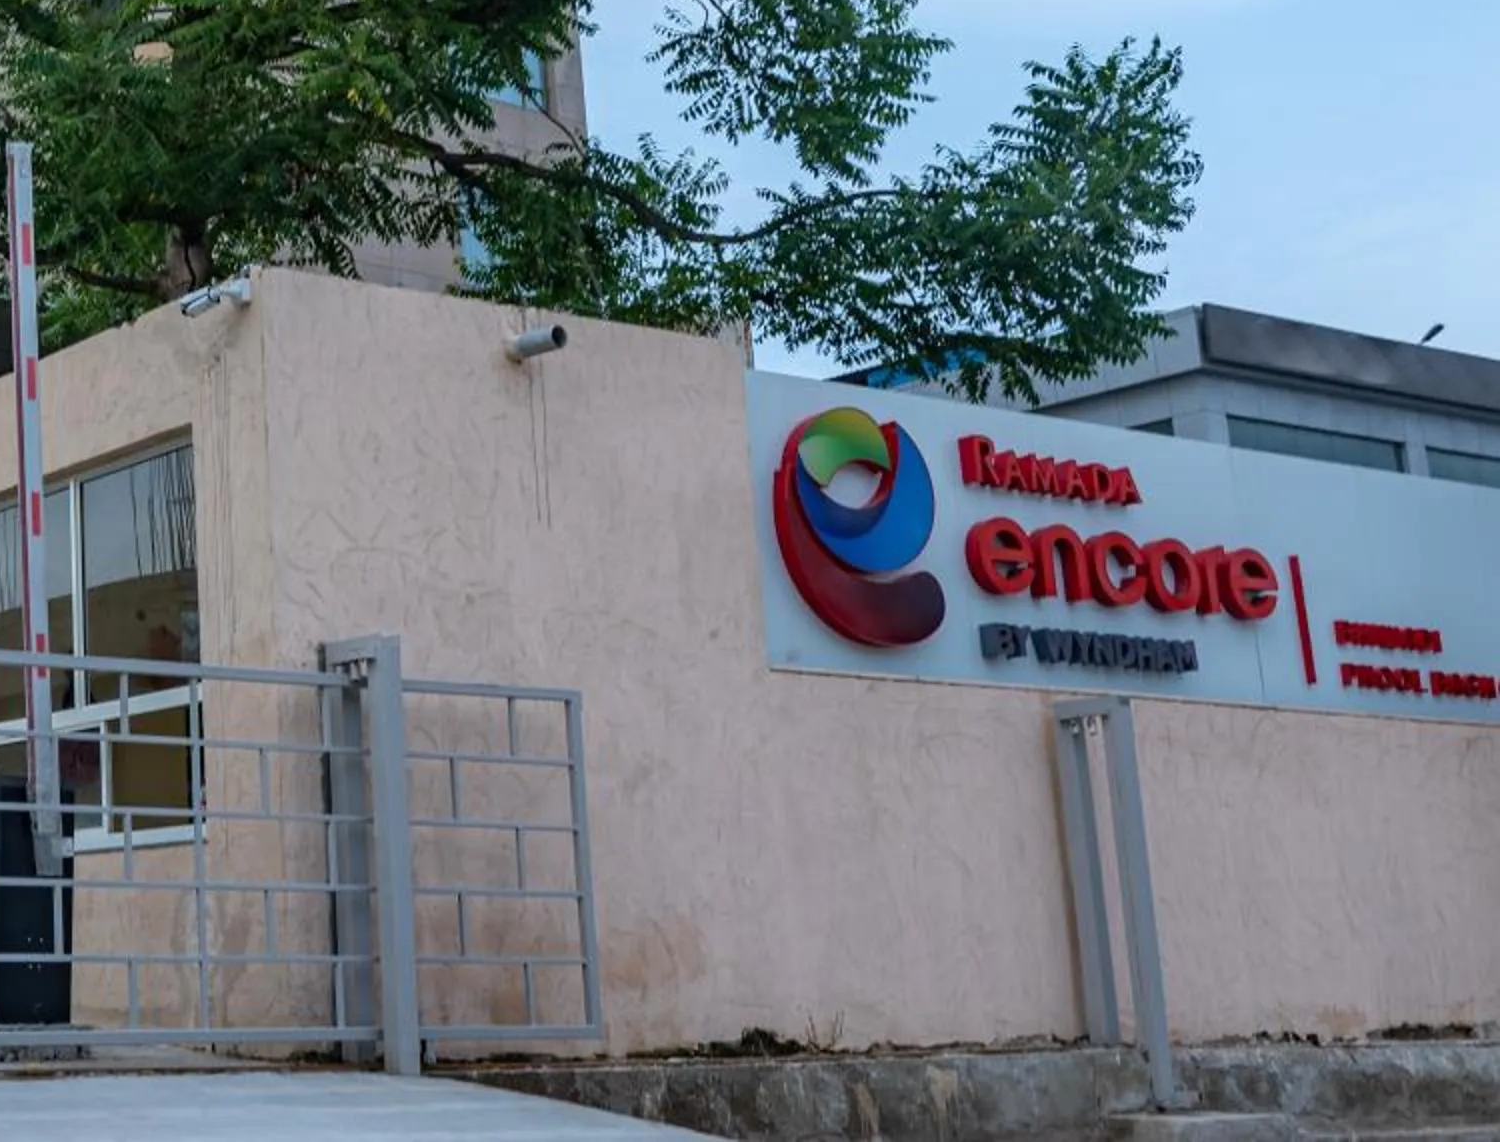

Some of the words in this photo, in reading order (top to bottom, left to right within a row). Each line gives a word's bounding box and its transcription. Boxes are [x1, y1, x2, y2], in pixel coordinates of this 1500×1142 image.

[958, 434, 1141, 506] RAMADA
[964, 515, 1279, 620] encore
[979, 622, 1030, 659] BY
[1031, 627, 1199, 674] WYNDHAM
